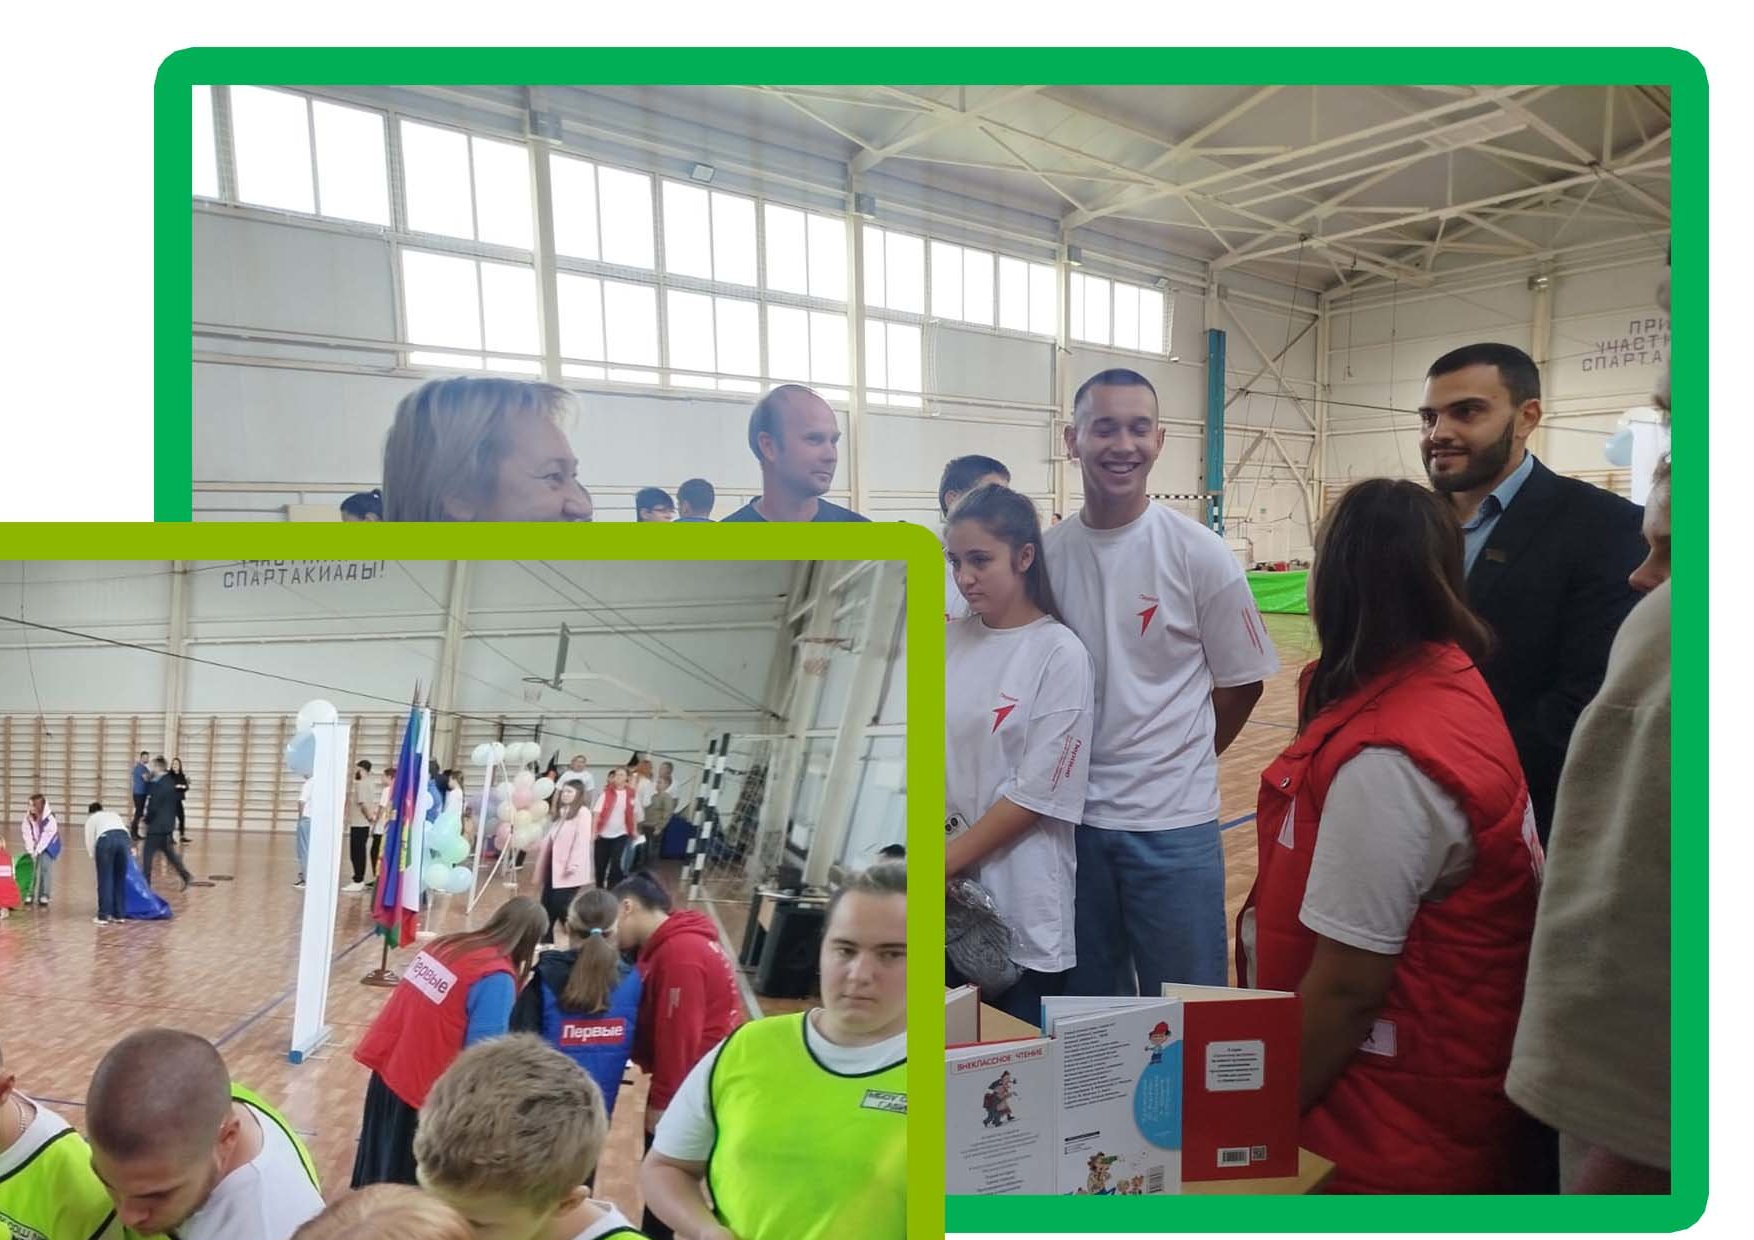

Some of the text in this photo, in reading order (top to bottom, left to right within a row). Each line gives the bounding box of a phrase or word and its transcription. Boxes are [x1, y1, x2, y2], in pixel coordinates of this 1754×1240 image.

[223, 560, 384, 588] СПАРТАКИАДЫ!
[563, 1023, 624, 1041] Первые
[957, 1048, 1043, 1071] ВНЕКЛАССНОЕ ЧТЕНИЕ
